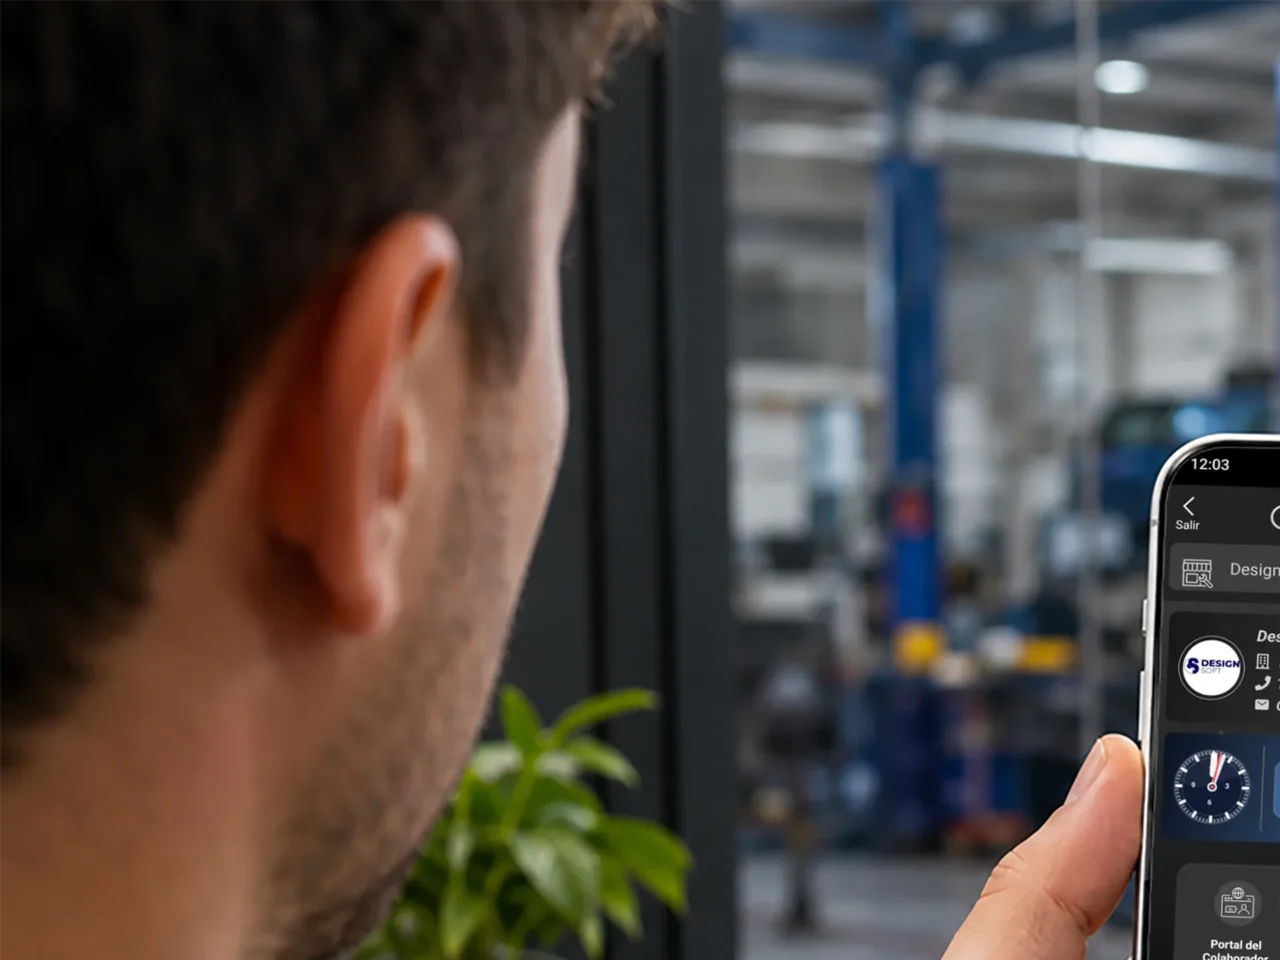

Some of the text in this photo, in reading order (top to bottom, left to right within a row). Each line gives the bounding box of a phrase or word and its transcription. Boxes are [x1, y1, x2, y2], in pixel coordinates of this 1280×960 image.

[1192, 458, 1229, 470] 12:03
[1176, 520, 1200, 530] Salir
[1231, 563, 1280, 579] Design
[1201, 659, 1240, 668] DESIGN
[1211, 940, 1261, 950] Portal del
